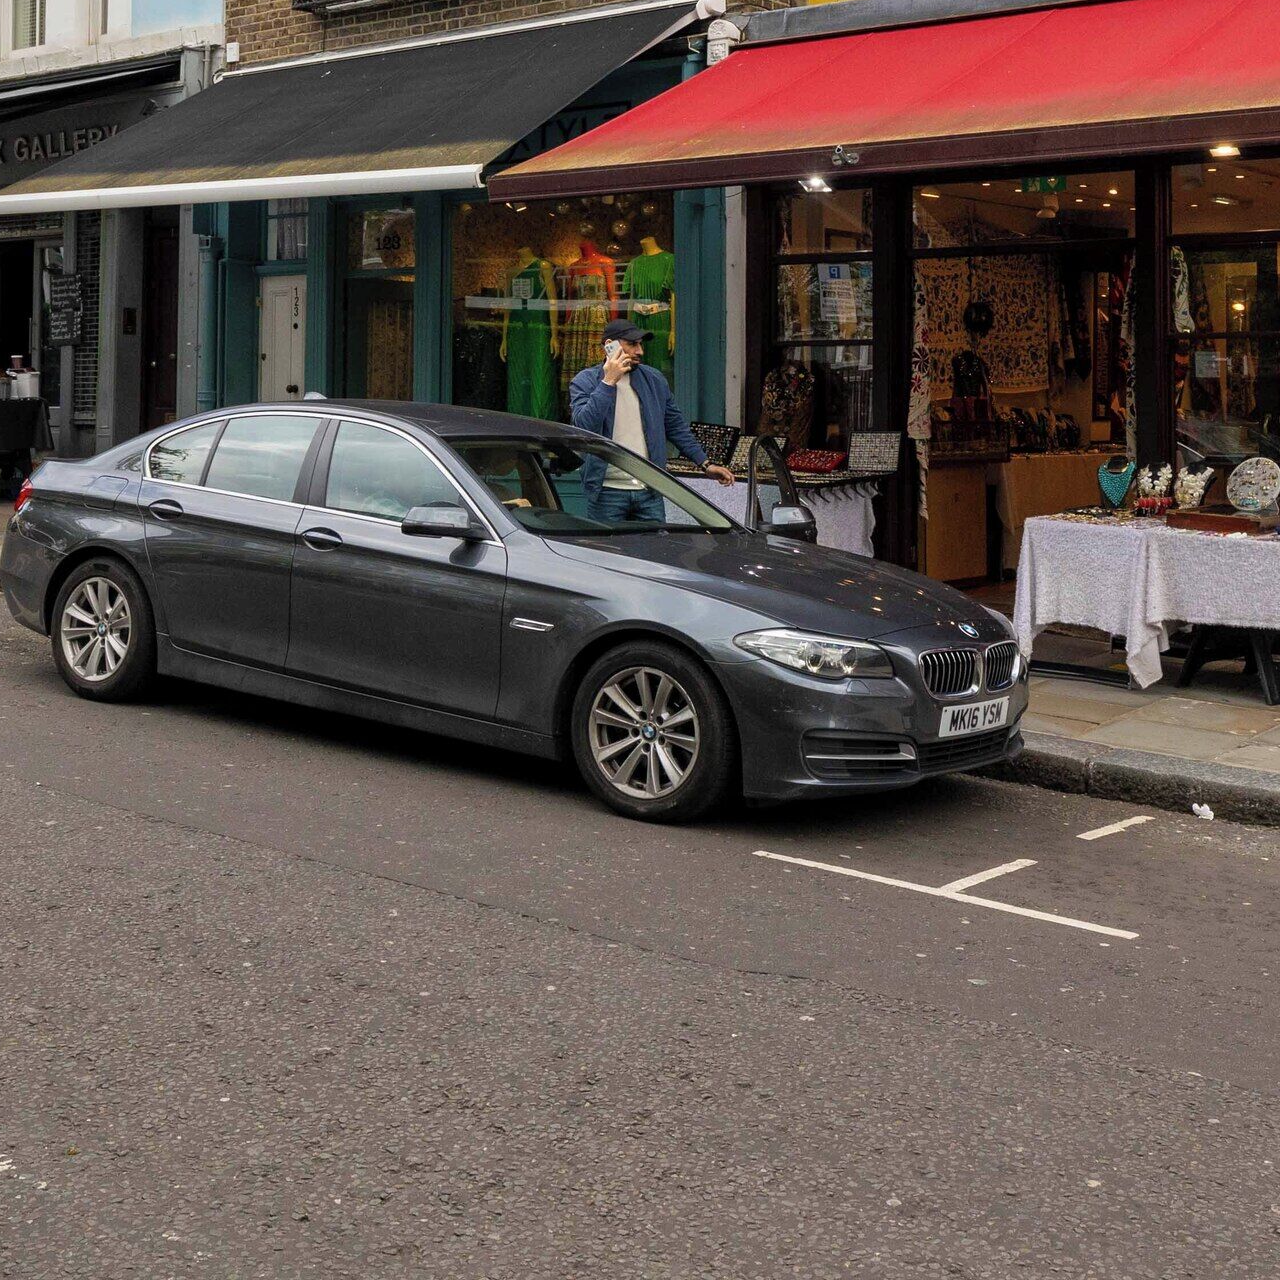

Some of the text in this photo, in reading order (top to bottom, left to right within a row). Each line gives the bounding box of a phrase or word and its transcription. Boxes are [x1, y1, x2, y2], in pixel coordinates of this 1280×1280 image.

[292, 286, 300, 317] 123
[949, 701, 1003, 732] MK16 YSM
